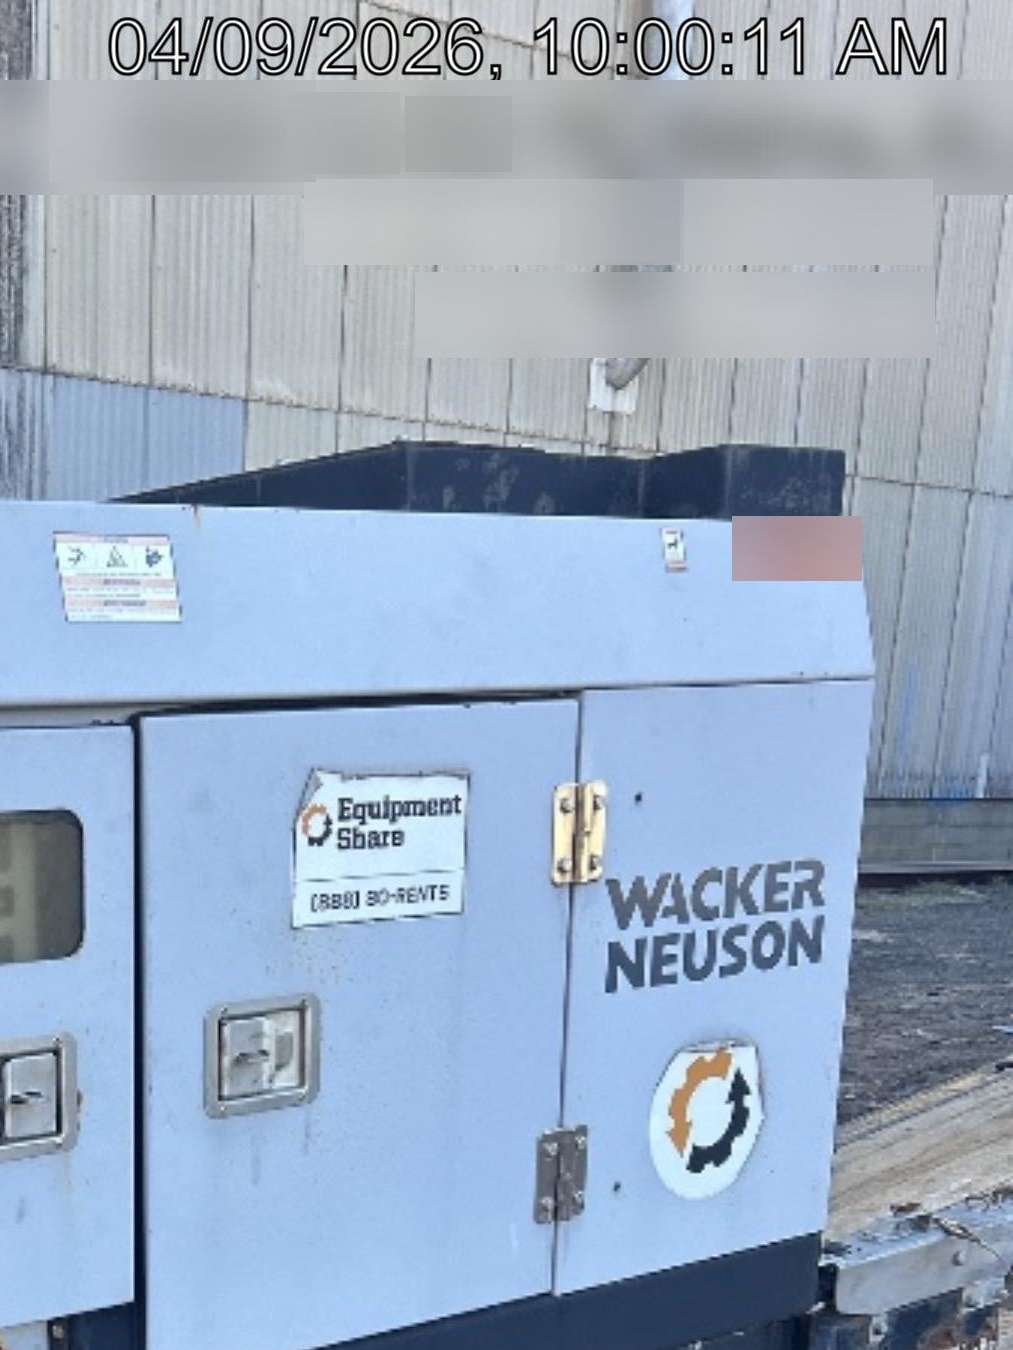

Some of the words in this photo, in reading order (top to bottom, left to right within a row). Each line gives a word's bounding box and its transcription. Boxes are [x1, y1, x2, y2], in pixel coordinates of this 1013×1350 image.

[336, 794, 462, 825] Equipment
[336, 827, 406, 850] Share
[605, 860, 826, 931] WACKER
[605, 914, 826, 994] NEUSON
